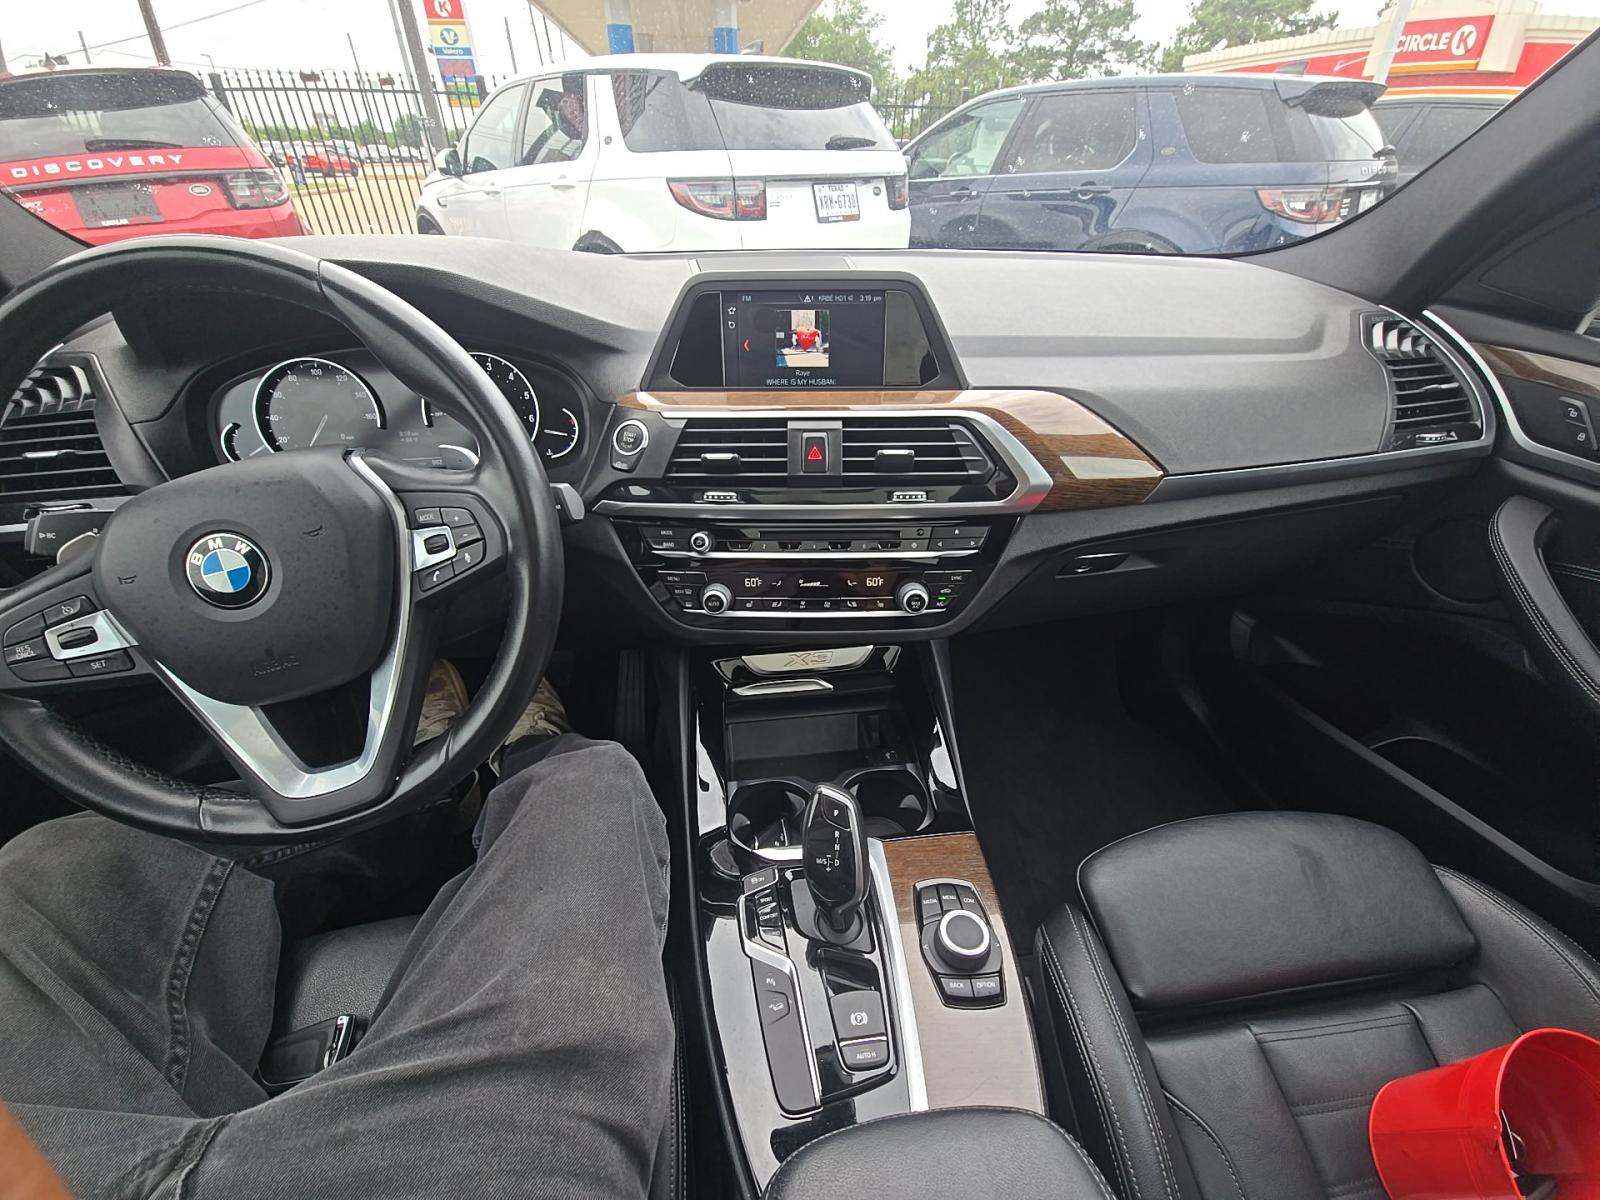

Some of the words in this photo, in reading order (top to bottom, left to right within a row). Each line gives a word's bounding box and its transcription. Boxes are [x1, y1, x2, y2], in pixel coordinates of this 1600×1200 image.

[1395, 31, 1452, 53] CIRCLE
[1451, 24, 1477, 56] K
[10, 154, 183, 178] DISCOVERY
[486, 362, 492, 371] 3
[310, 368, 322, 376] 100
[508, 372, 514, 381] 4
[766, 378, 788, 386] WHERE
[523, 391, 530, 400] 5
[528, 414, 535, 423] 6
[418, 513, 434, 521] MODE
[190, 537, 252, 567] BMW
[16, 644, 31, 652] RES
[784, 651, 833, 667] X3
[90, 660, 107, 670] SET
[833, 809, 839, 817] P
[834, 830, 840, 838] R
[834, 843, 841, 851] N
[834, 859, 840, 867] D
[976, 981, 996, 989] OPTION
